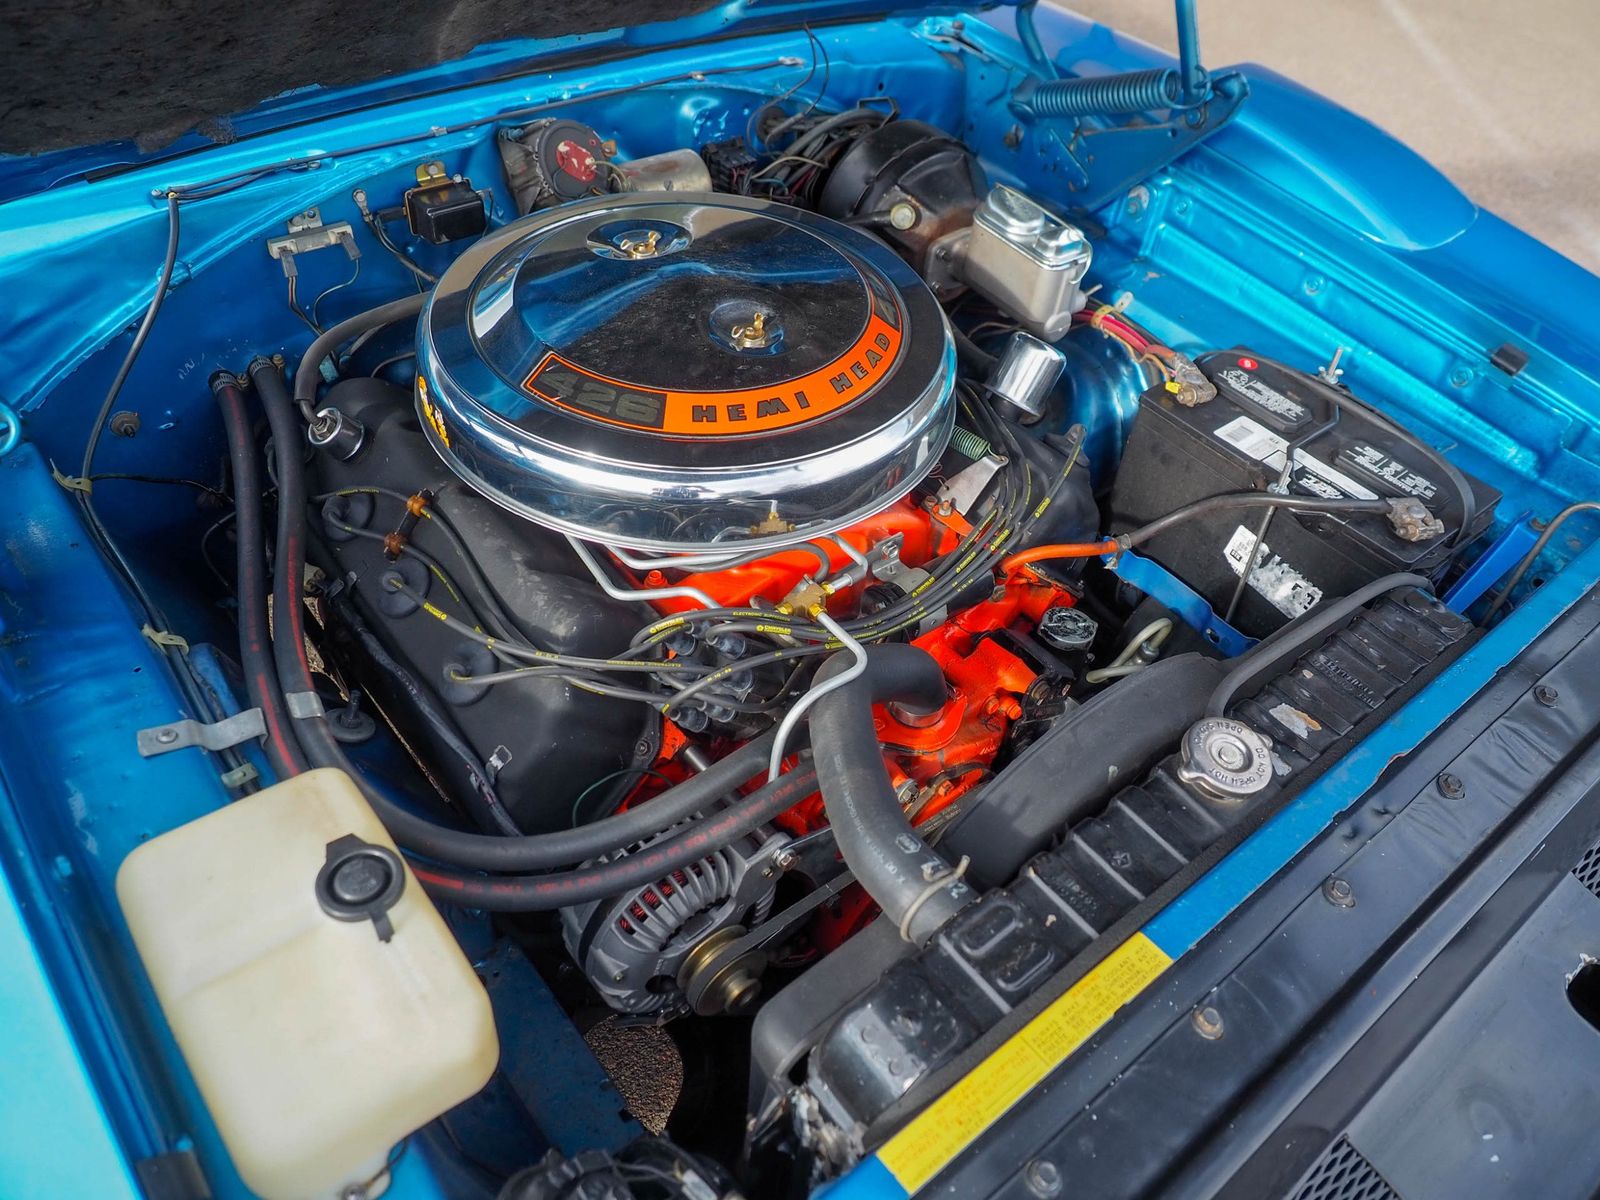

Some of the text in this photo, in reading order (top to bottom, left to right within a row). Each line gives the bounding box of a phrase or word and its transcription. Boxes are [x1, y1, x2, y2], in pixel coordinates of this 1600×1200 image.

[538, 332, 891, 425] 426 HEMI HEAD
